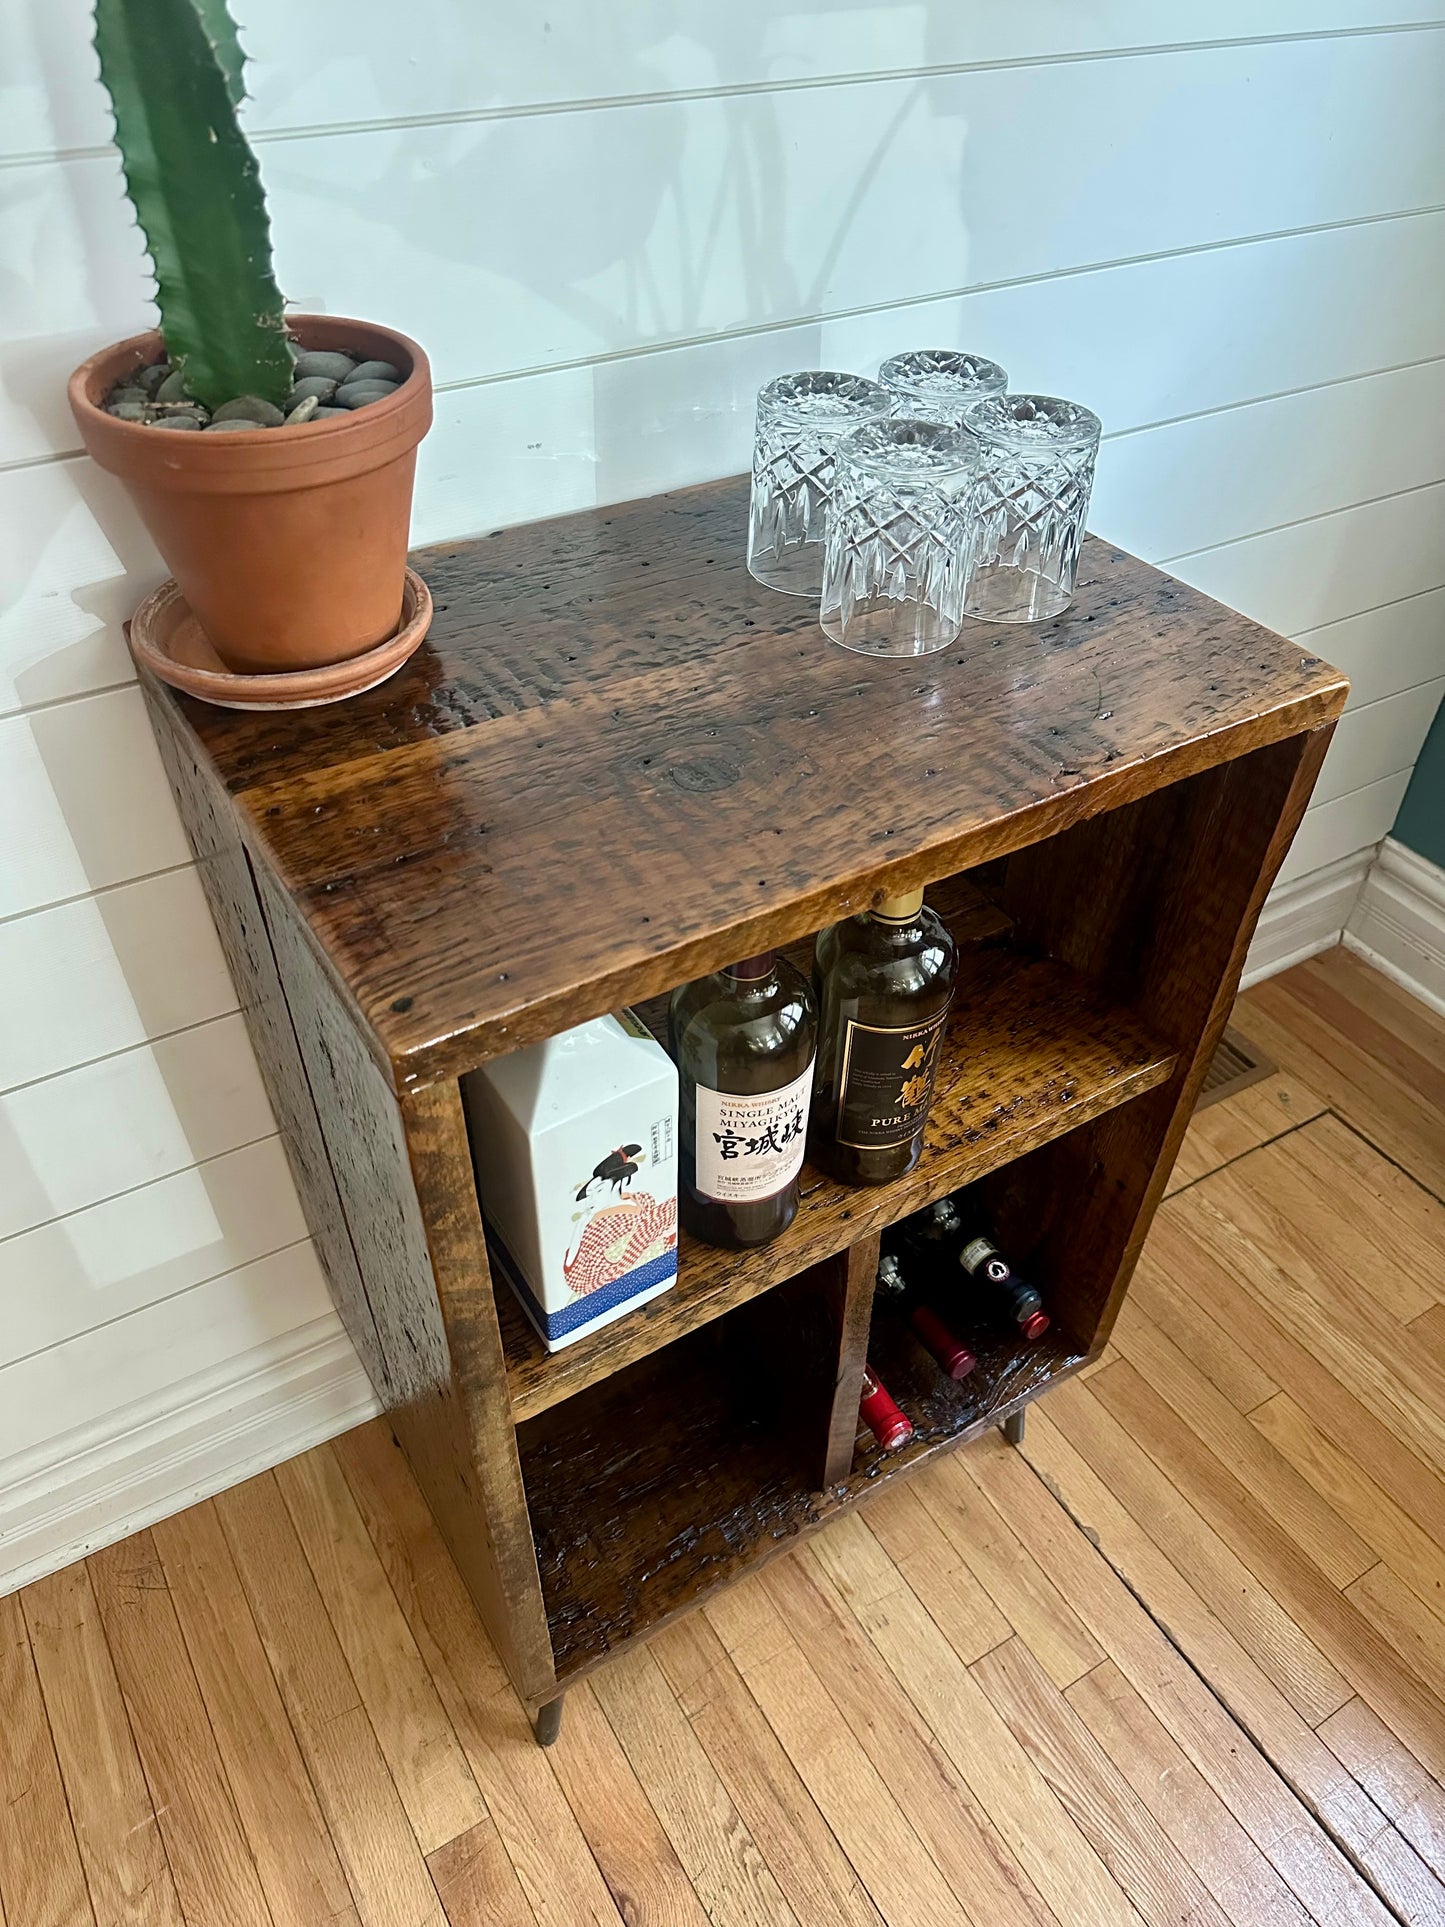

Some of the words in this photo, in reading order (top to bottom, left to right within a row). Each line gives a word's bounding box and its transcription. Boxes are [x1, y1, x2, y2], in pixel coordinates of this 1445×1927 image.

[902, 1029, 928, 1041] NIKKA
[719, 1106, 775, 1119] SINGLE
[778, 1086, 806, 1110] MALT
[720, 1100, 750, 1109] NIKKA
[750, 1096, 782, 1108] WHISKY
[719, 1104, 799, 1129] MIYAGIKYO
[870, 1112, 912, 1127] PURE
